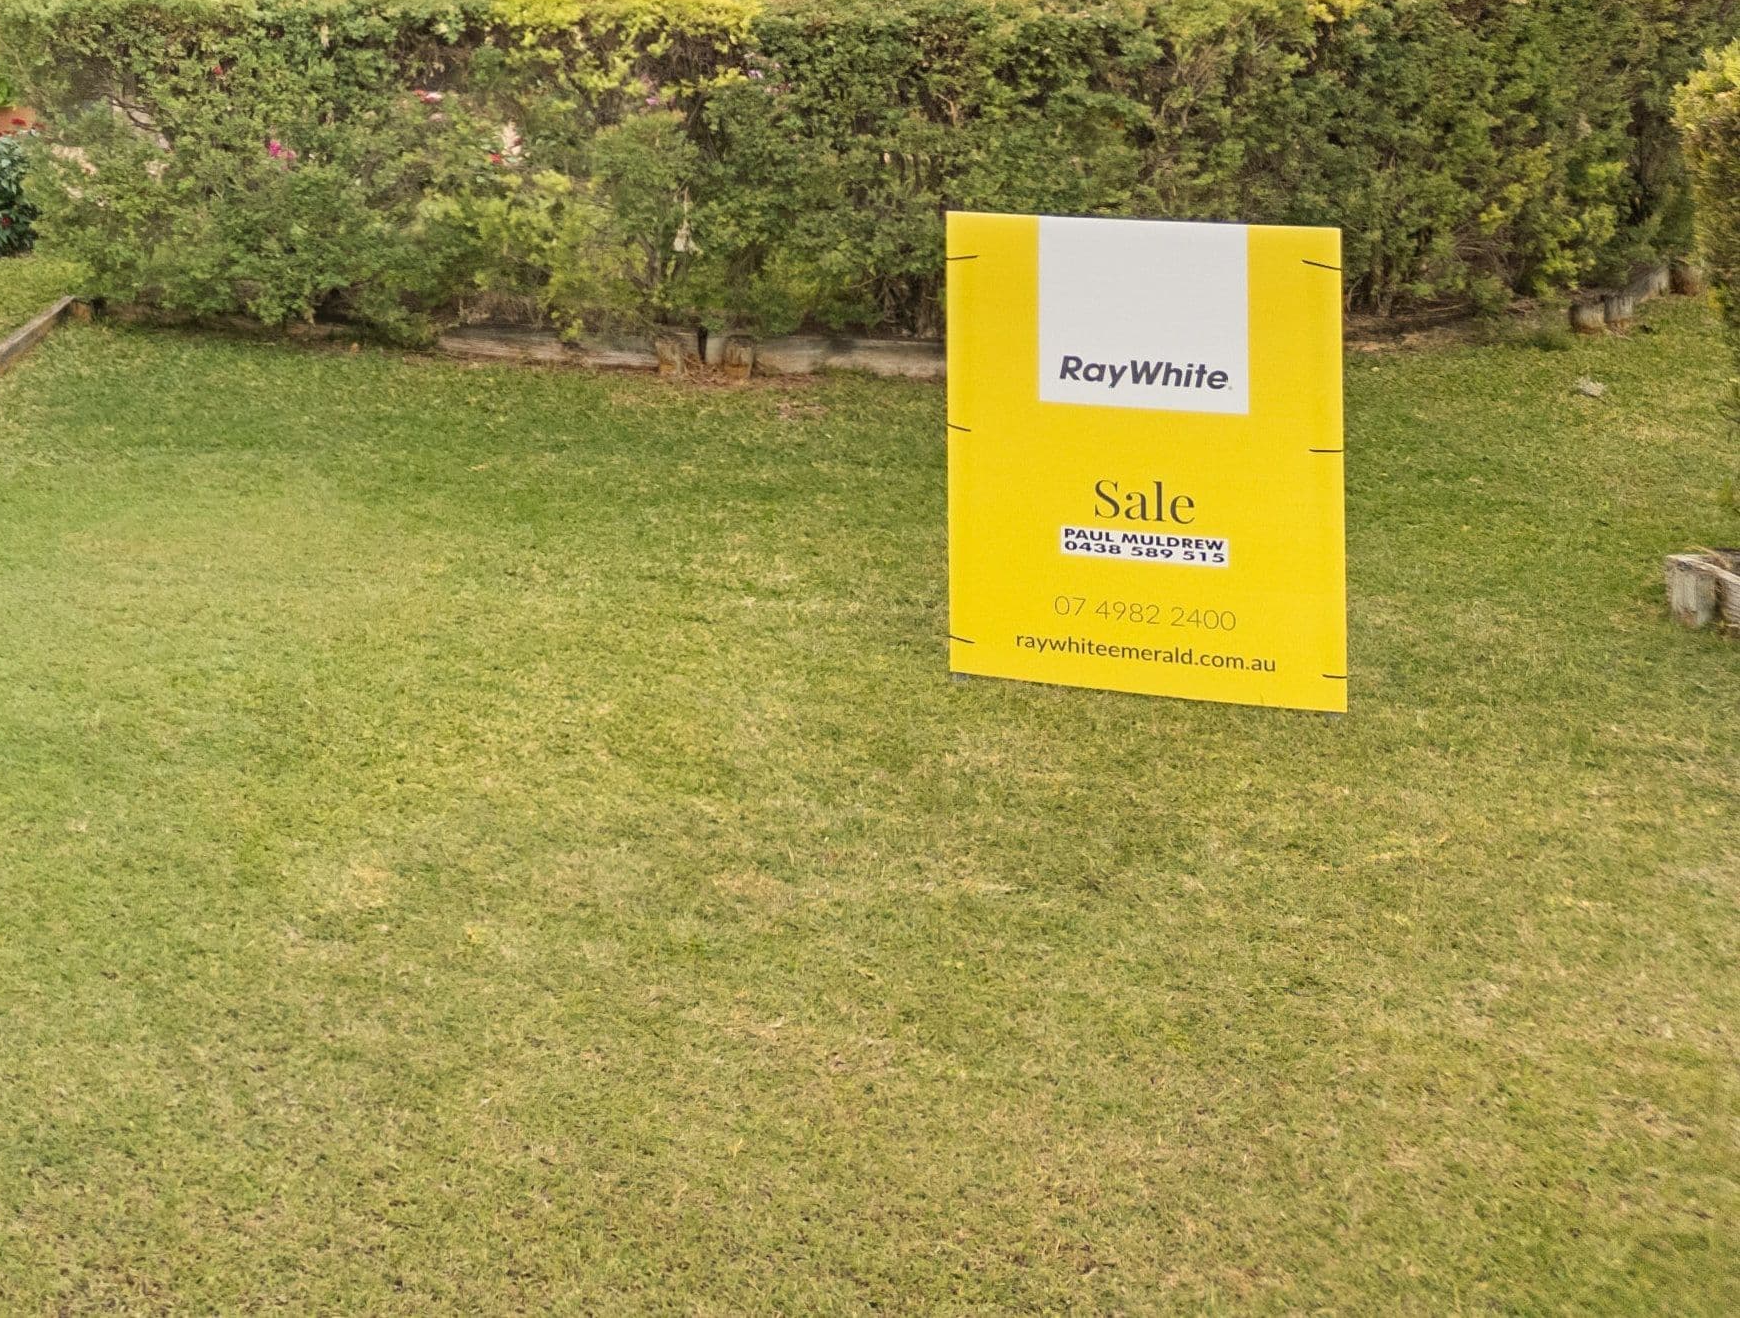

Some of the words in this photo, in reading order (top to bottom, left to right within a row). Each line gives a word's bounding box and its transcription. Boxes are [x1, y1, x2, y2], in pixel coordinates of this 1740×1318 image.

[1094, 479, 1196, 525] Sale
[1064, 528, 1115, 543] PAUL
[1121, 532, 1225, 551] MULDREW
[1064, 540, 1122, 555] 0438
[1131, 546, 1174, 559] 589
[1183, 550, 1225, 563] 515
[1054, 595, 1086, 616] 07
[1095, 600, 1161, 625] 4982
[1170, 606, 1237, 631] 2400
[1016, 633, 1277, 673] raywhiteemerald.com.au
